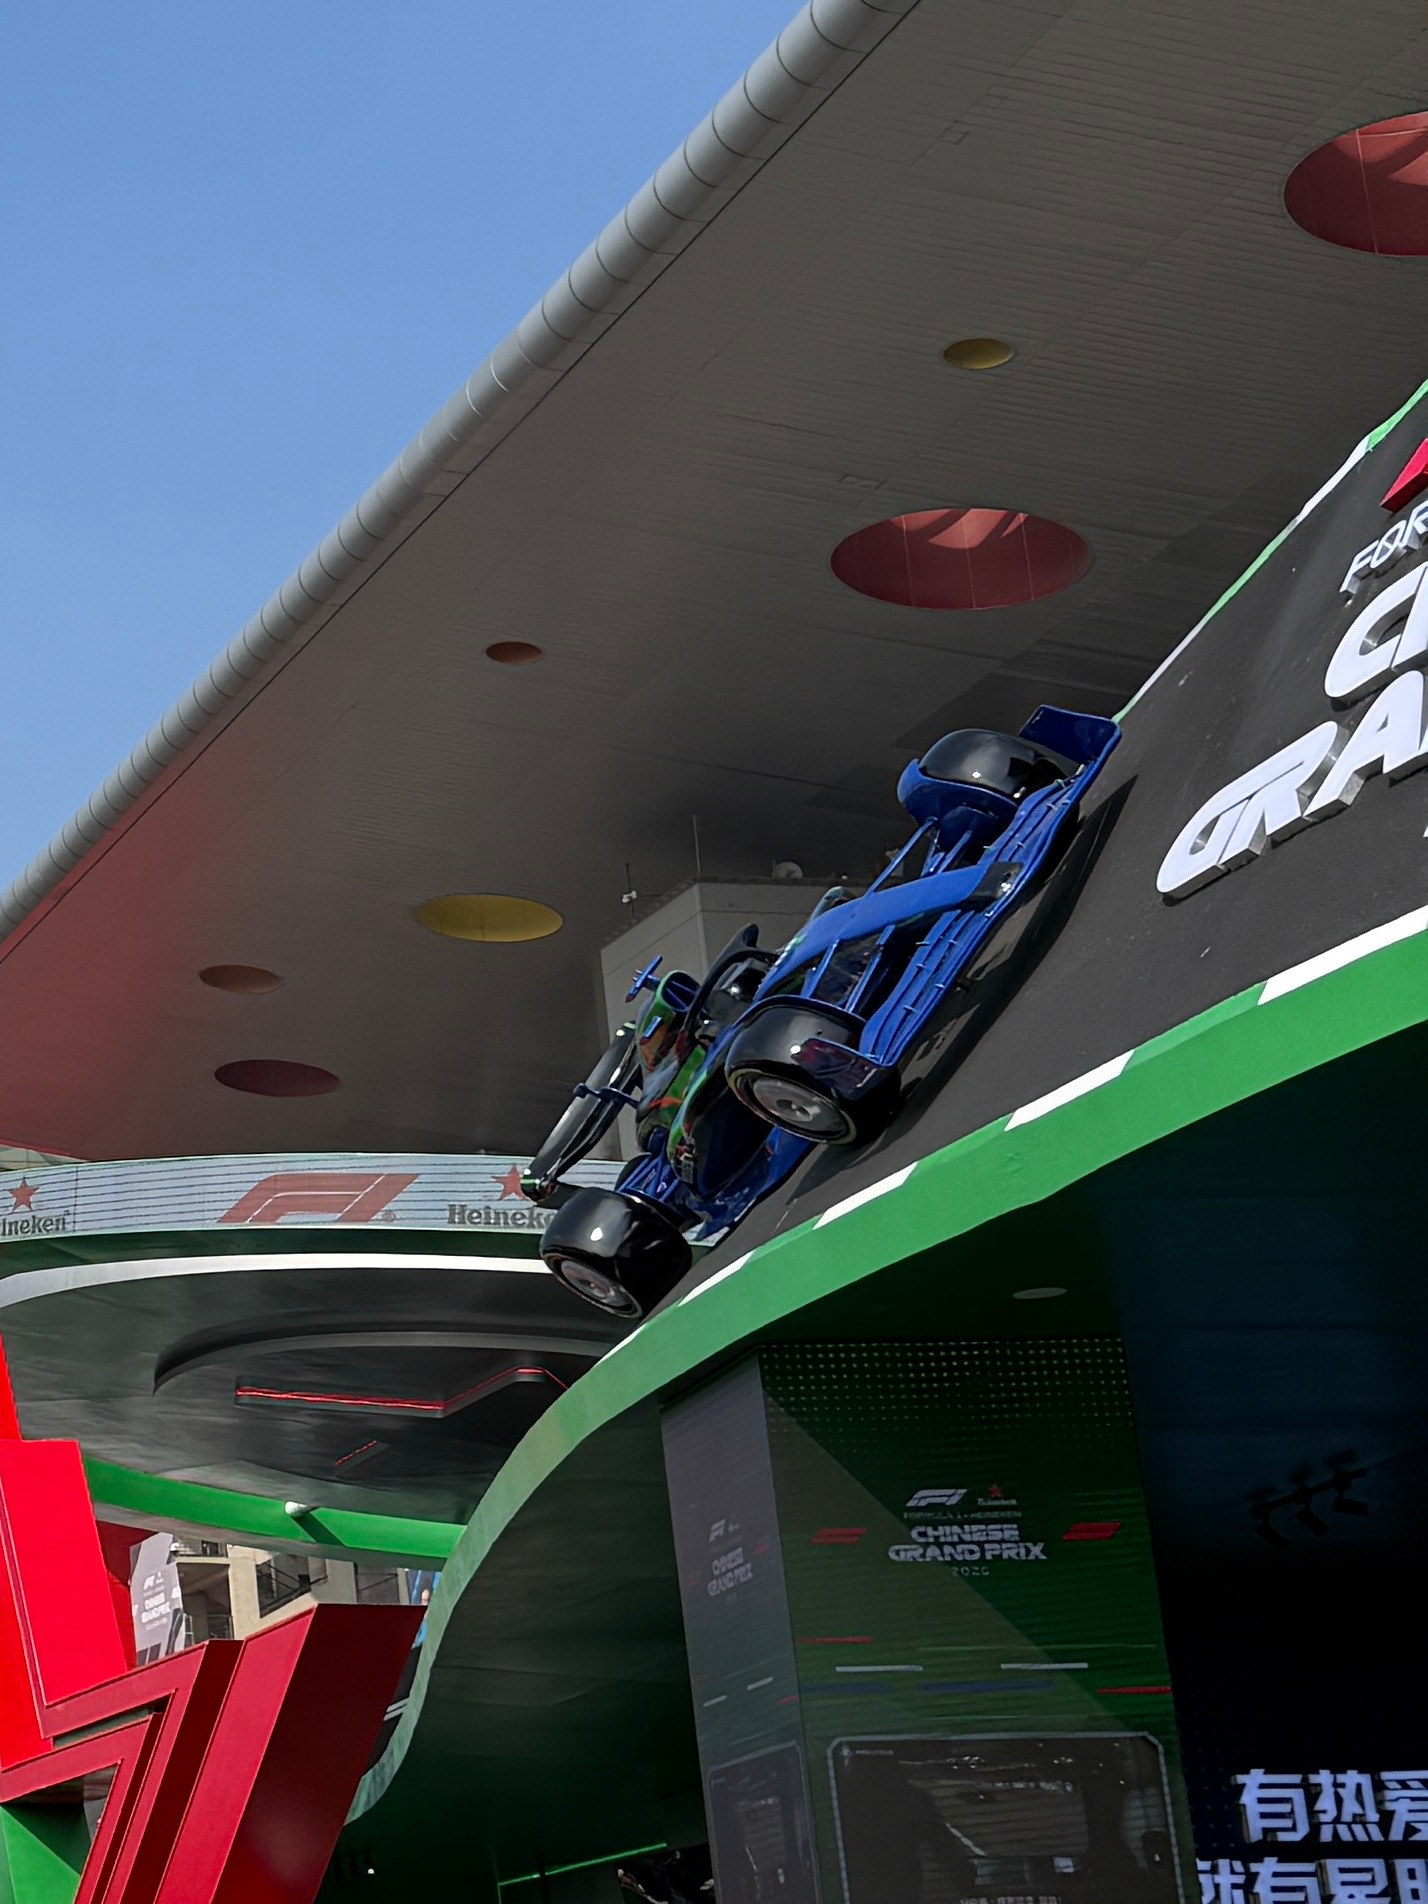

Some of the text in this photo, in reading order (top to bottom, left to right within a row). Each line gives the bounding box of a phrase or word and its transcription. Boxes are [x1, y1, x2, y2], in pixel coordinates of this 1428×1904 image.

[216, 1173, 420, 1224] F1
[446, 1204, 556, 1231] Heinek
[905, 1489, 968, 1506] F1
[910, 1524, 1021, 1543] CHINESE
[888, 1542, 1048, 1562] GRAND PRIX
[1236, 1768, 1428, 1844] 有热爱
